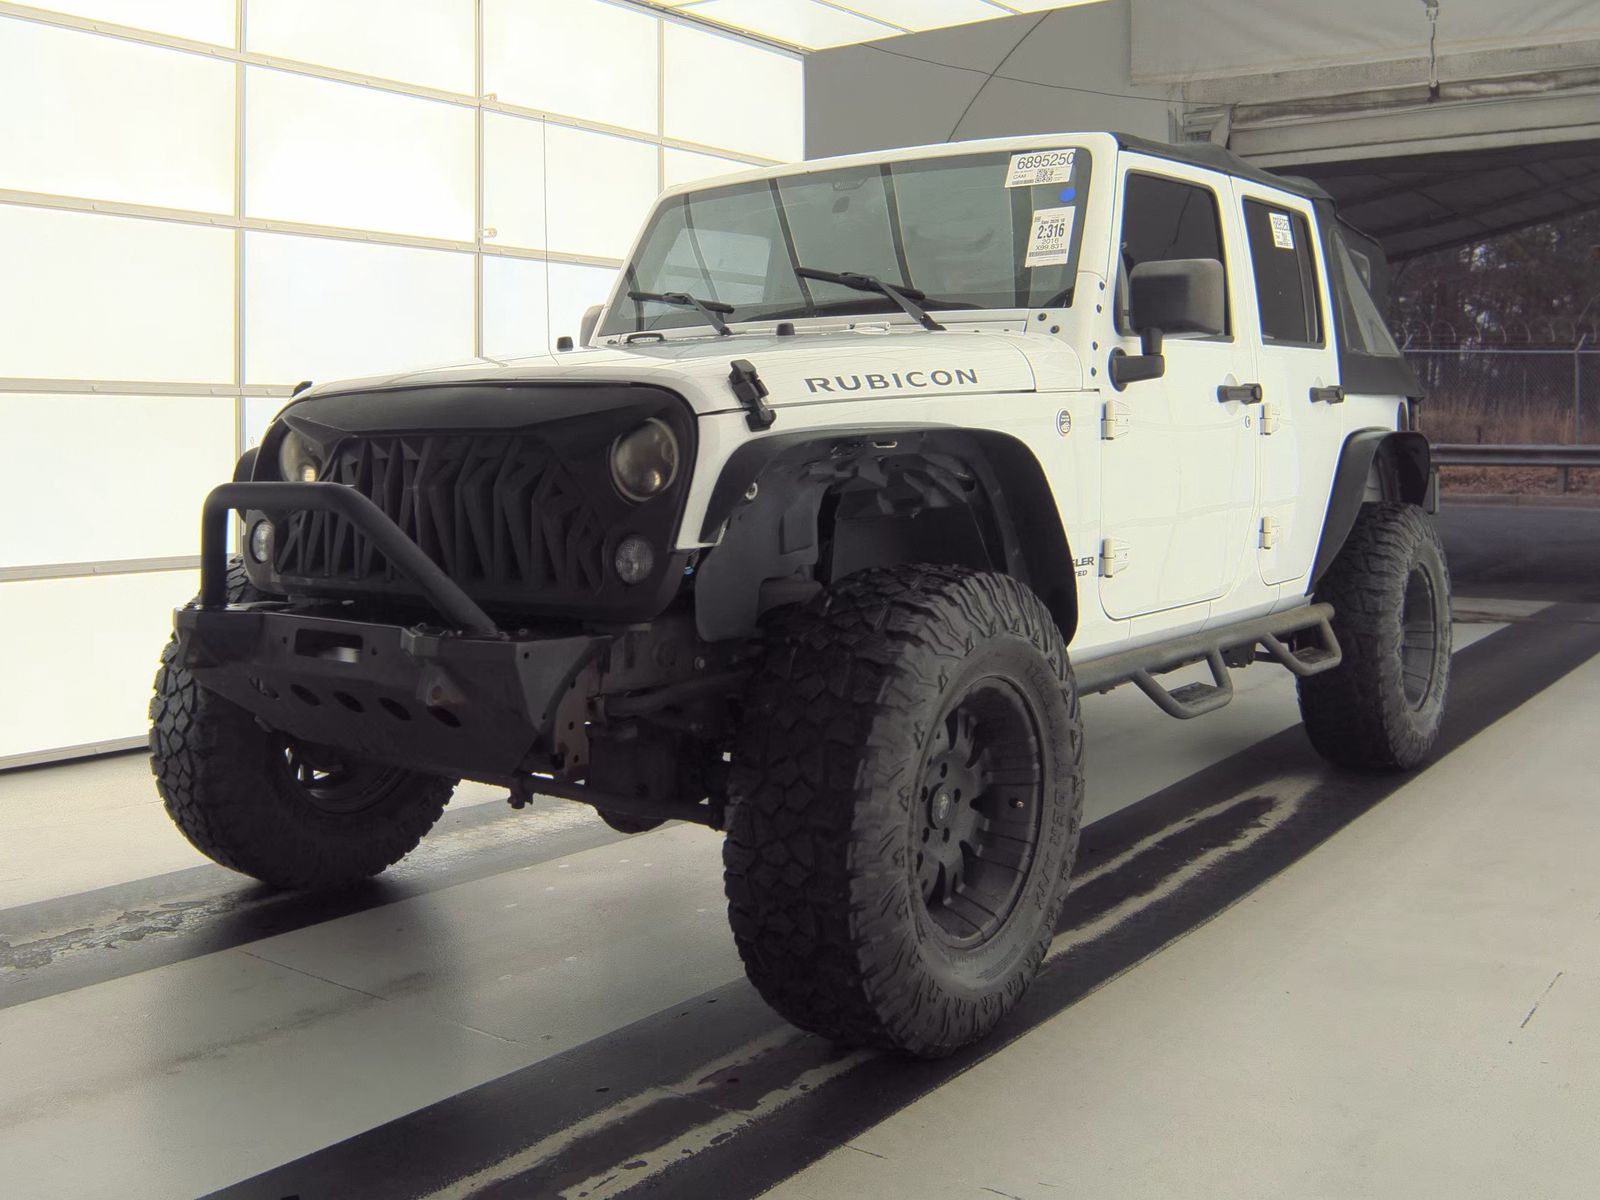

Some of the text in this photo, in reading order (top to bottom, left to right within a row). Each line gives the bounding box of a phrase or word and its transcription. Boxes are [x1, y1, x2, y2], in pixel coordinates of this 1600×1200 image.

[1017, 151, 1074, 170] 6895250
[1037, 223, 1065, 239] 2:316
[804, 368, 978, 393] RUBICON
[1074, 557, 1095, 567] LER
